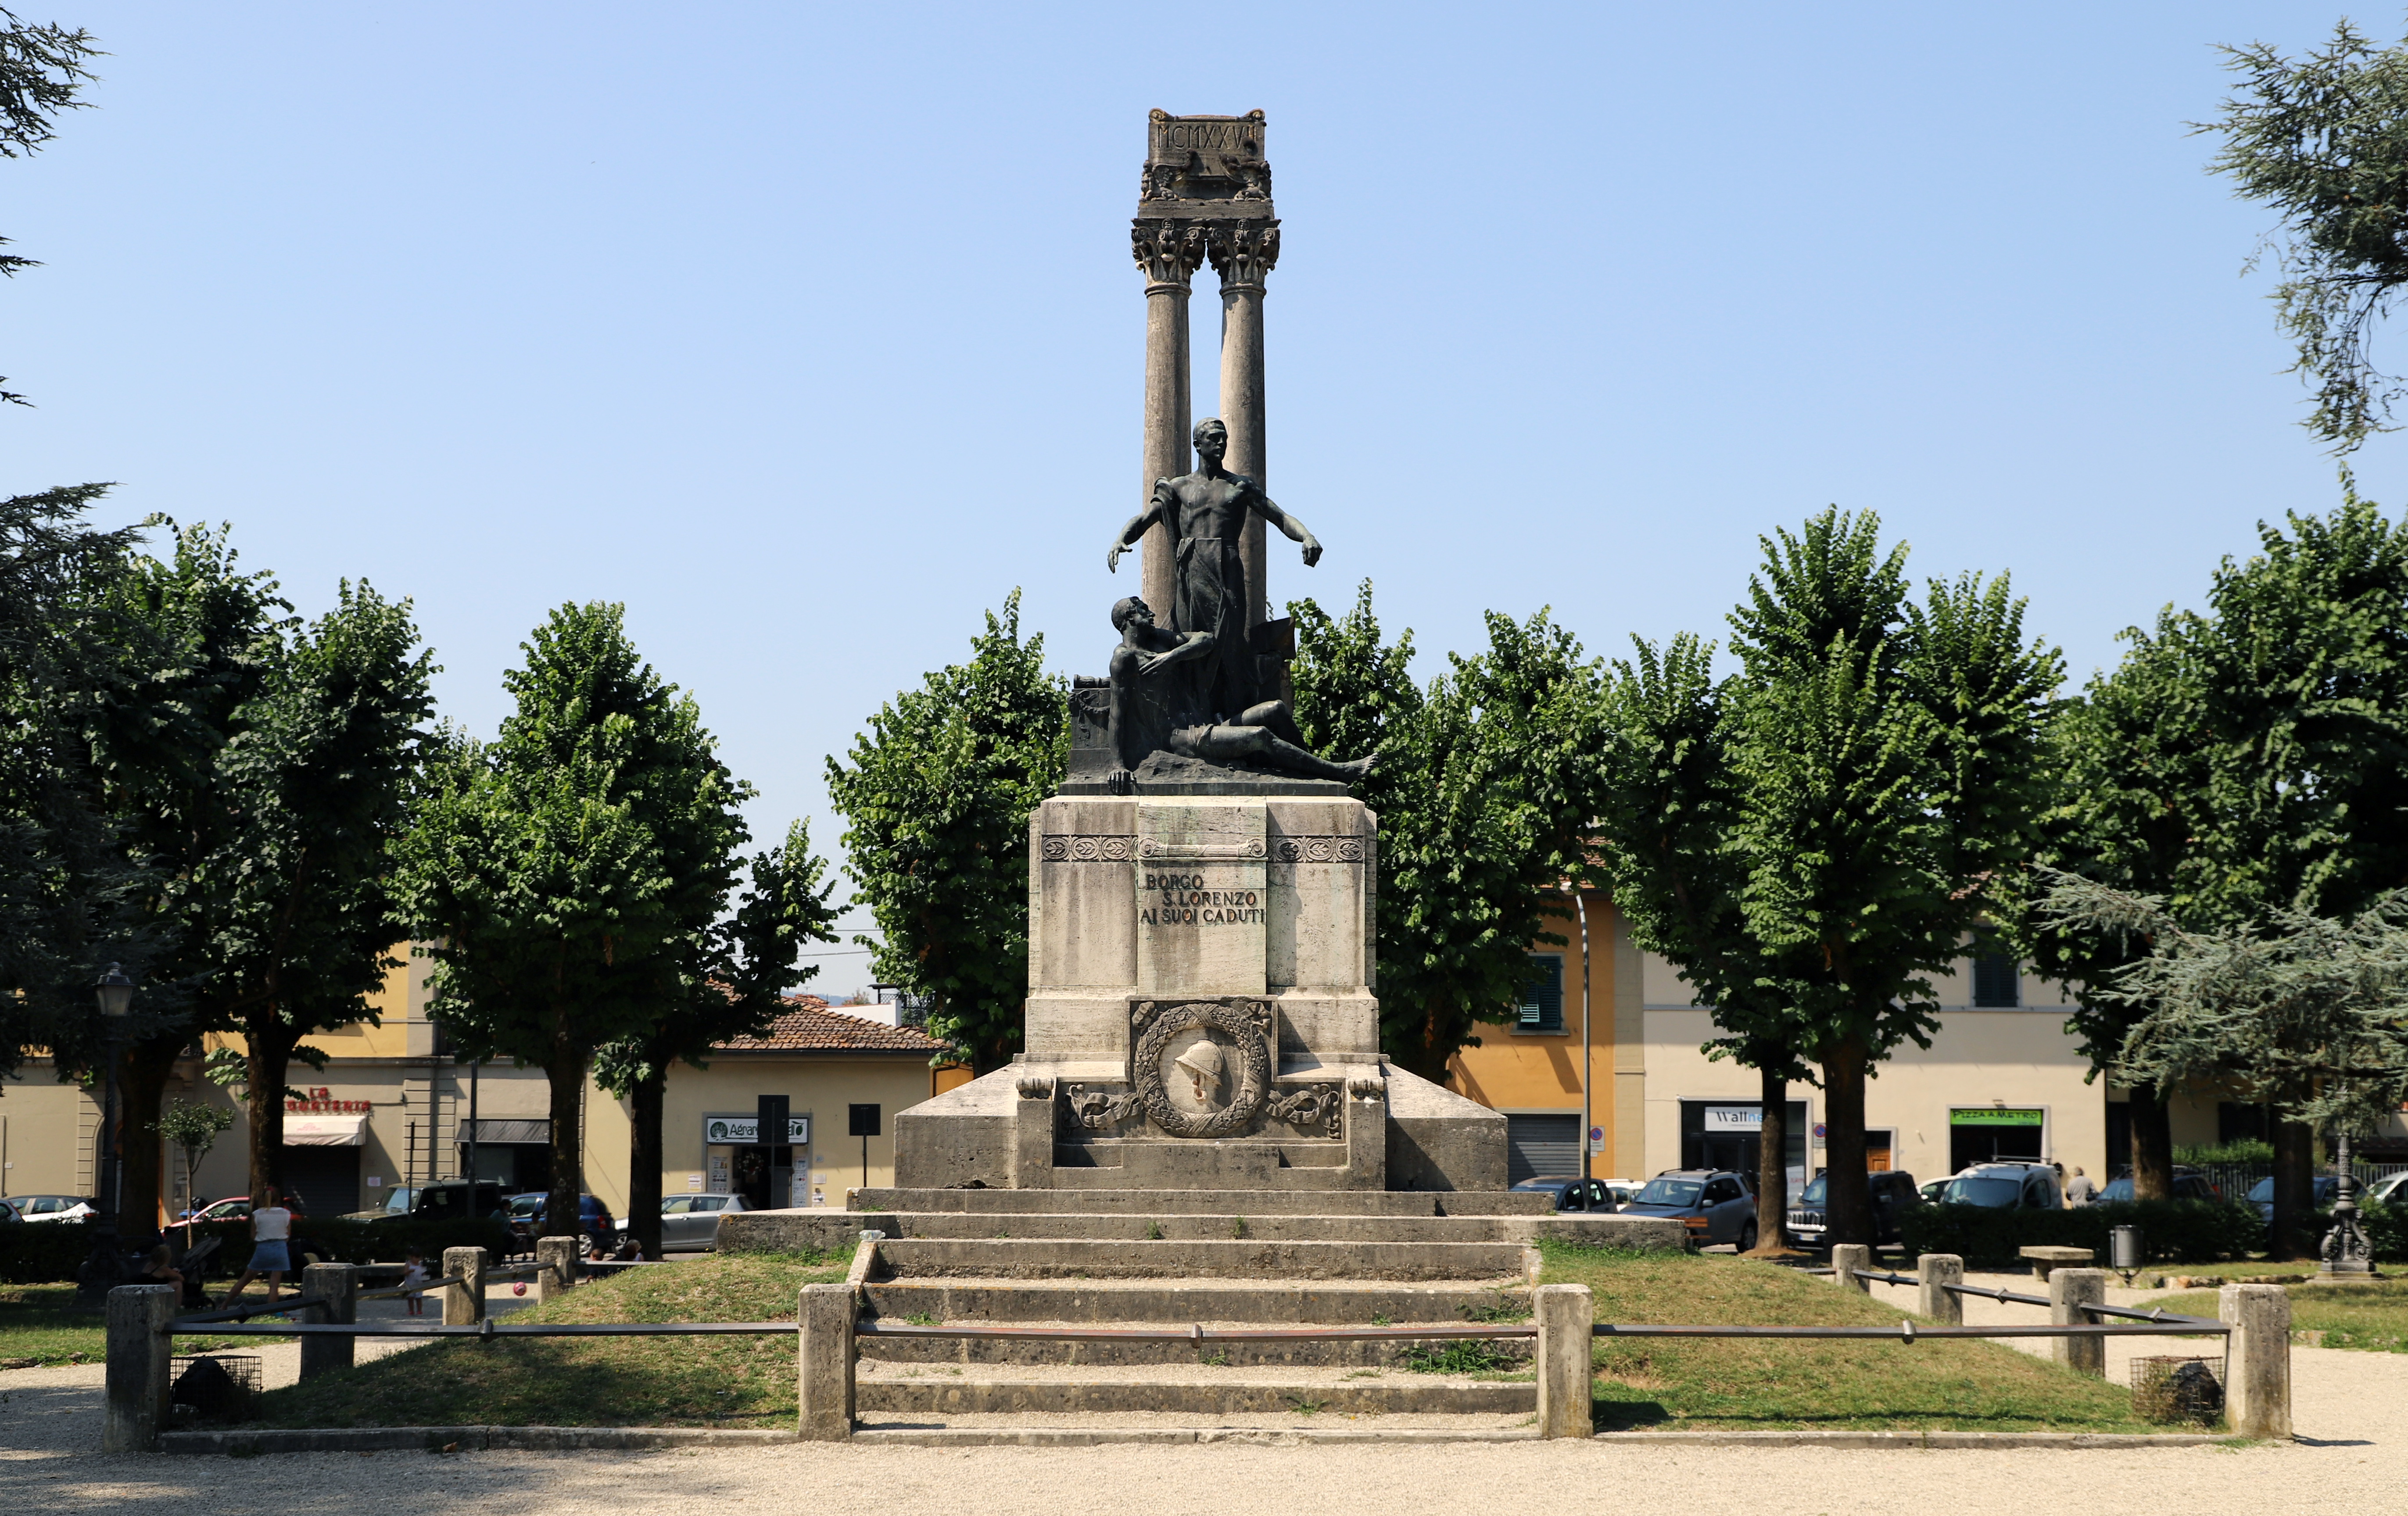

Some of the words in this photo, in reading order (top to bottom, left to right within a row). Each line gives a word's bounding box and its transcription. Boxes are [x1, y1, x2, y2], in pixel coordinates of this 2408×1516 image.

[1147, 875, 1204, 890] BORGO
[1163, 892, 1177, 907] S.
[1179, 892, 1256, 906] LORENZO
[1140, 908, 1157, 923] AI
[1162, 908, 1198, 922] SUOI
[1203, 908, 1265, 922] CADUTI
[1716, 1111, 1763, 1122] Wallne
